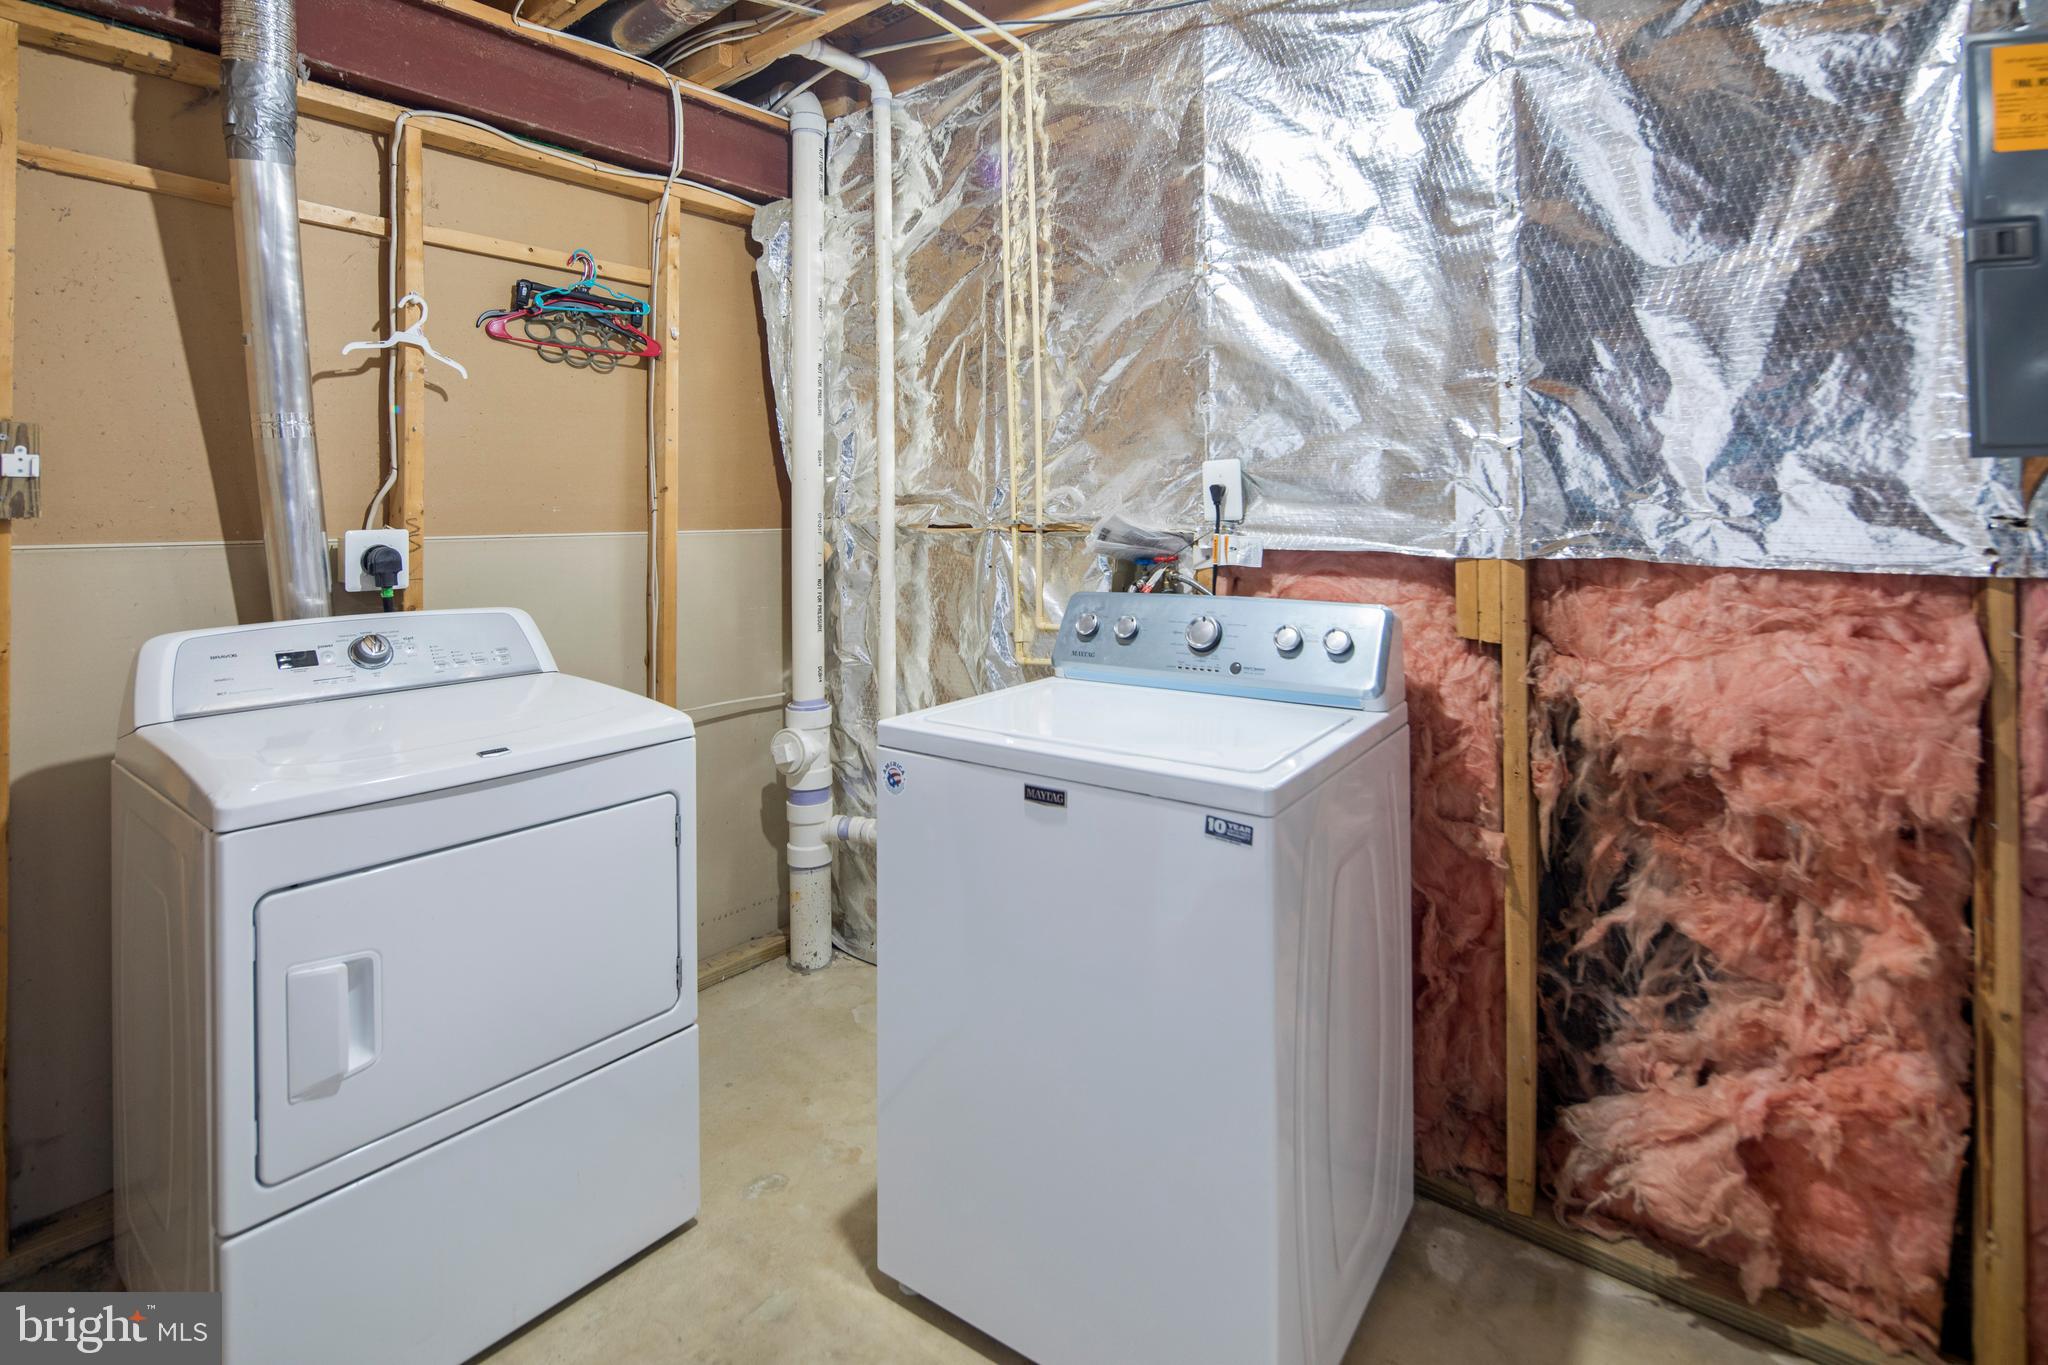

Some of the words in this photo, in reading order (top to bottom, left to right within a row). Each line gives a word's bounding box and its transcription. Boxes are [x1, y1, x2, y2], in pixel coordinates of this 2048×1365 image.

[1026, 788, 1065, 804] MAYTAG
[1207, 817, 1227, 834] 10
[1227, 822, 1252, 834] YEAR
